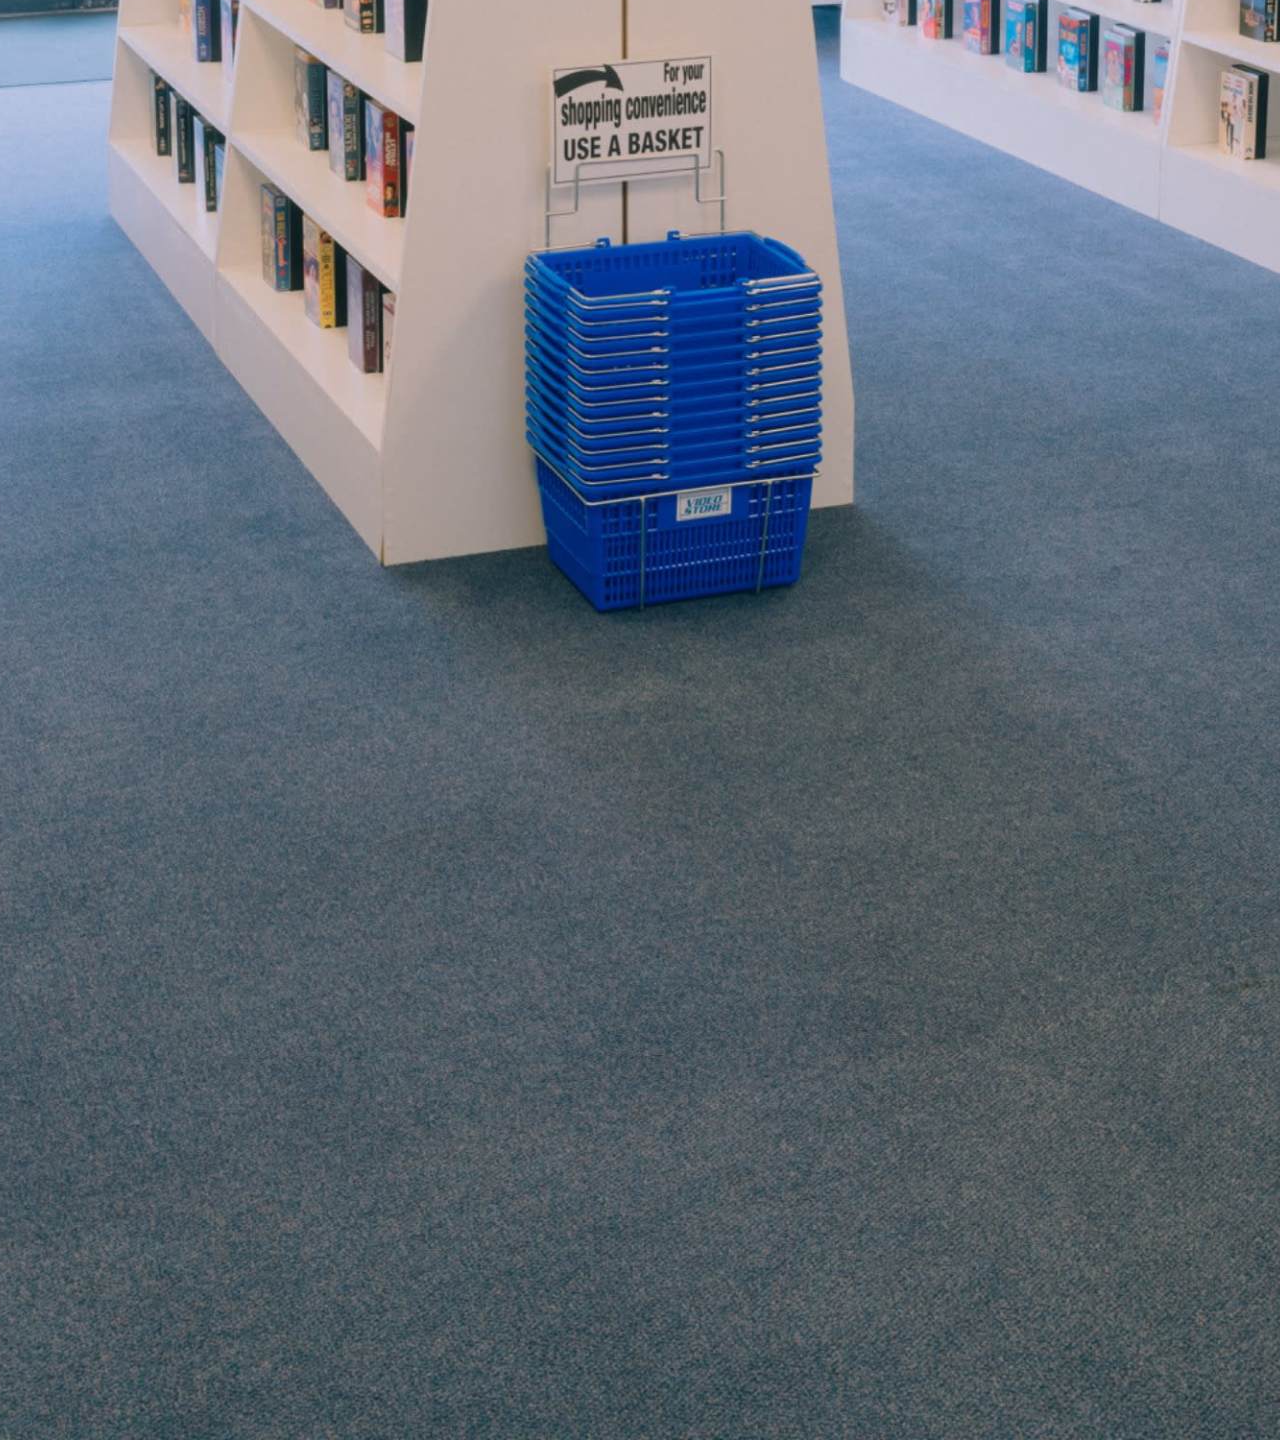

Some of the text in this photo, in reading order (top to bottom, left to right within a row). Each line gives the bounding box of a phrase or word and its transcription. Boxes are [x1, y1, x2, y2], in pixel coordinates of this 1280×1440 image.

[664, 62, 704, 85] For your
[561, 86, 707, 131] shopping convenience
[564, 126, 704, 161] USE A BASKET
